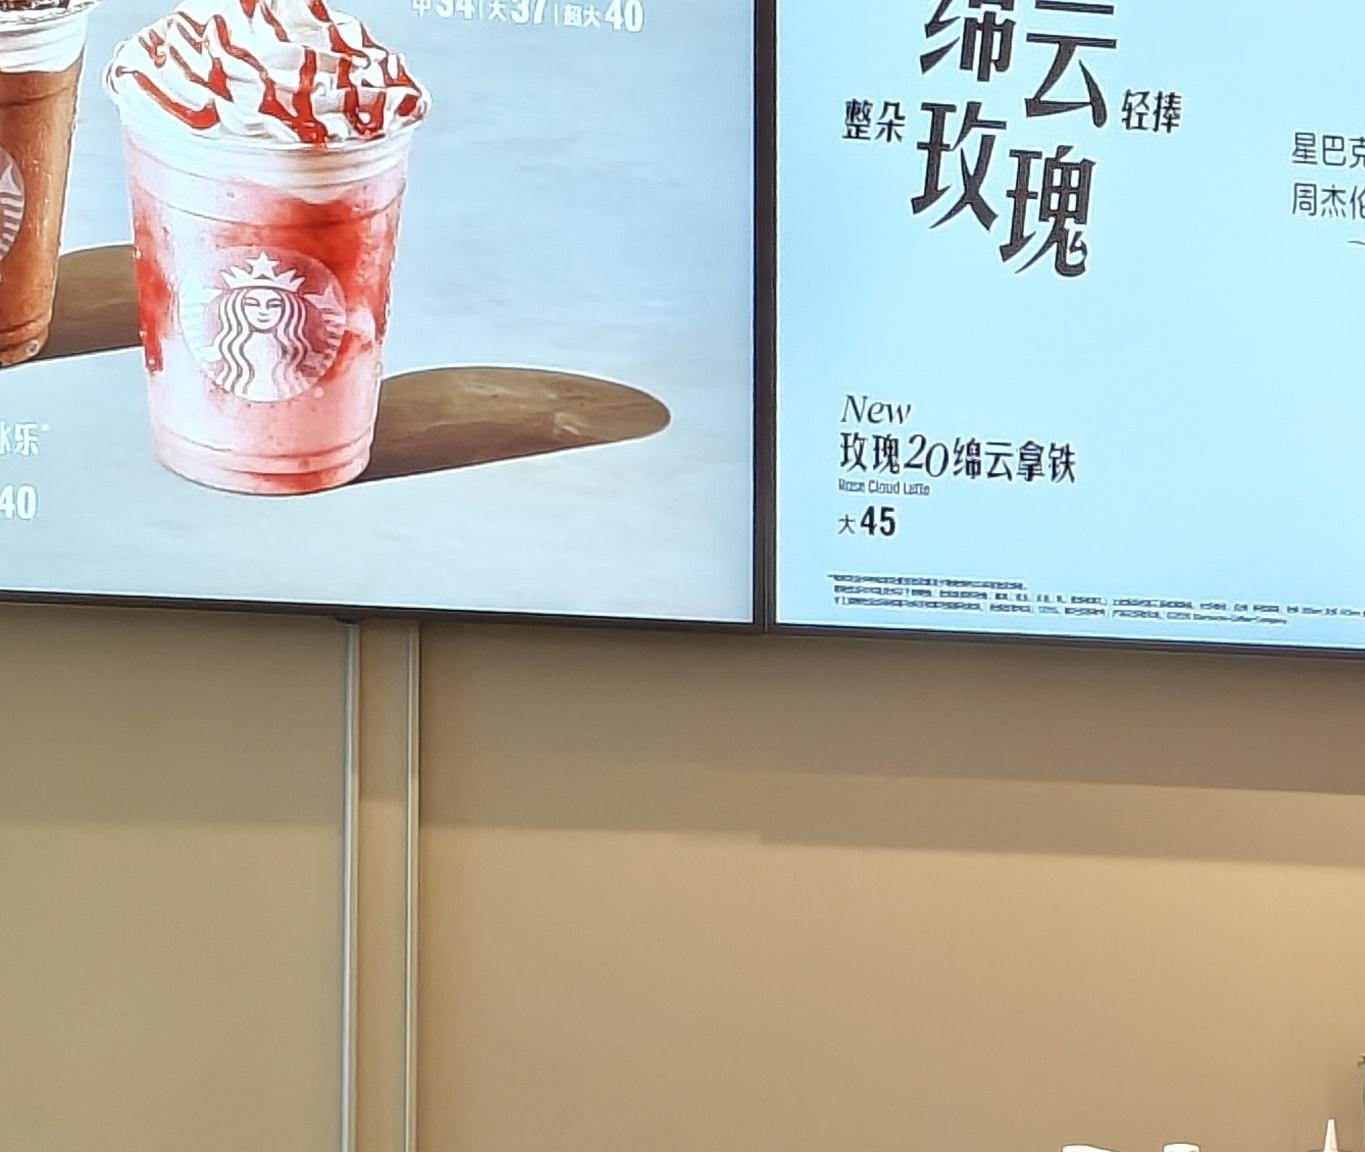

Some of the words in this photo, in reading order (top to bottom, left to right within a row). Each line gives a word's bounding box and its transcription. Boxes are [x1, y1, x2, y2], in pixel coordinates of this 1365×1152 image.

[842, 98, 906, 143] 整朵
[1121, 89, 1182, 134] 轻捧
[910, 101, 1097, 278] 玫瑰
[840, 394, 912, 425] New
[0, 484, 38, 520] 40
[868, 479, 900, 495] Cloud
